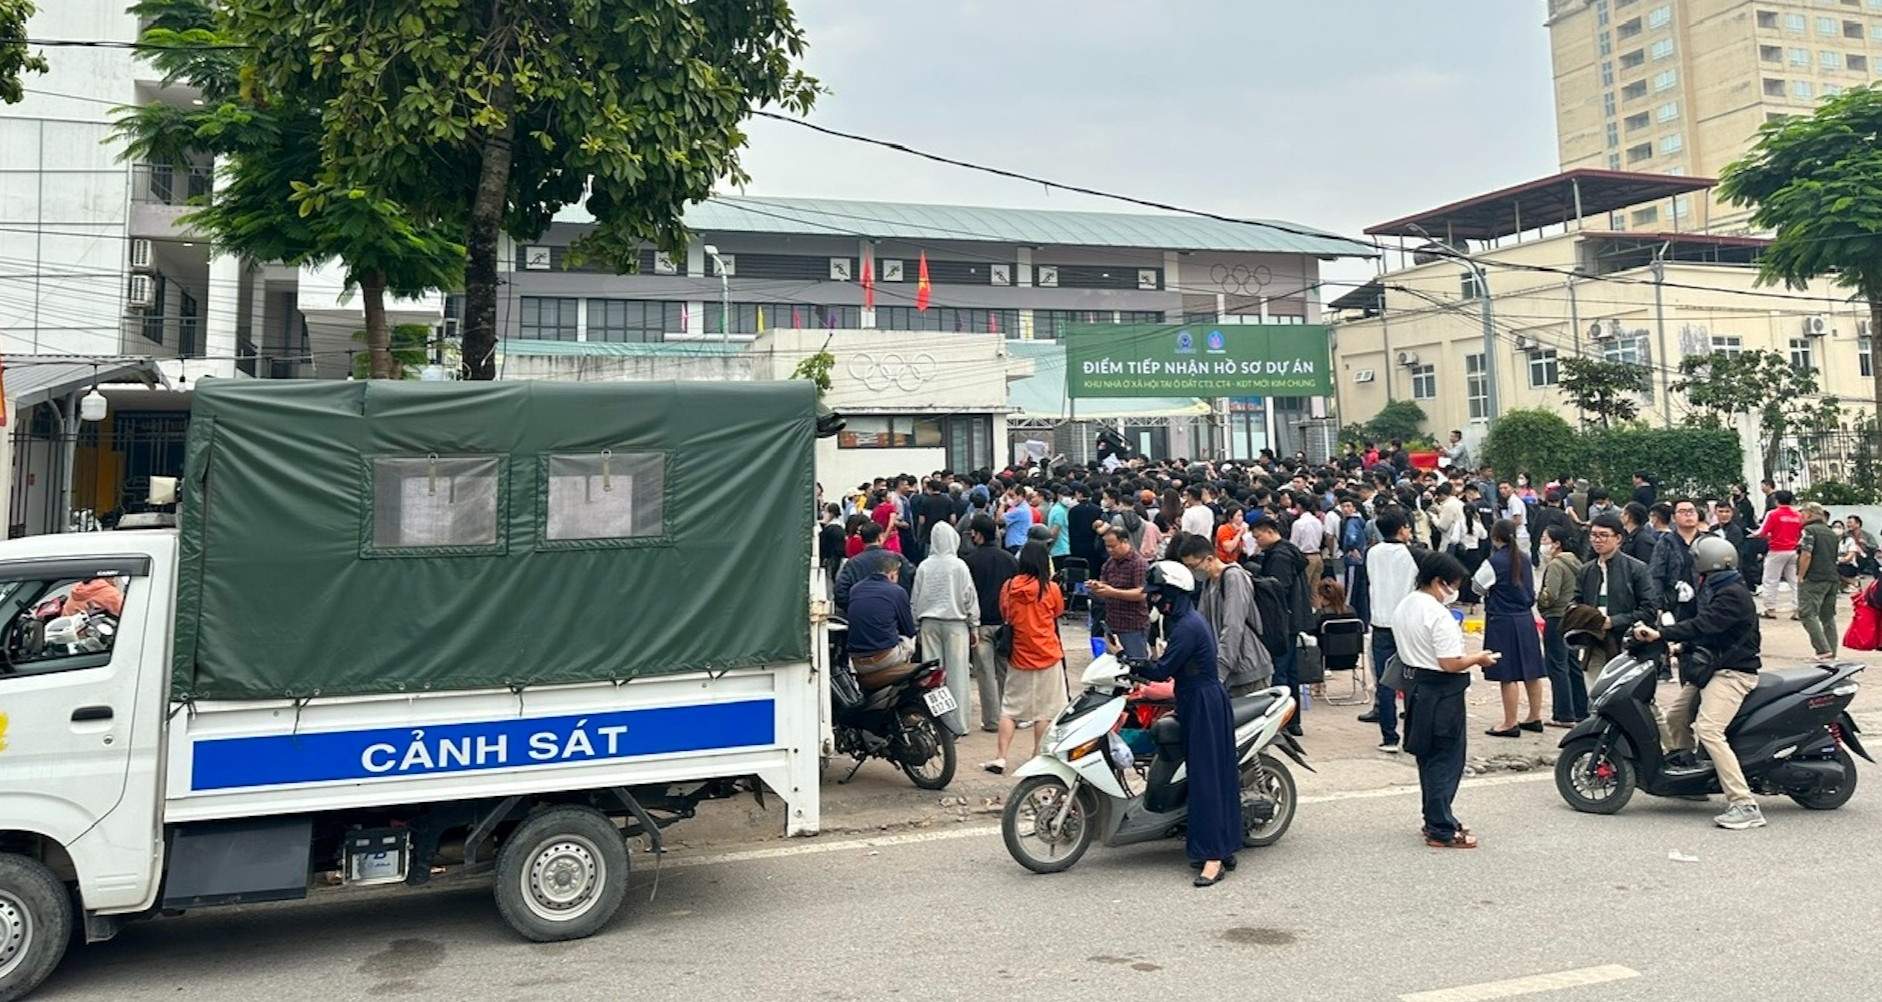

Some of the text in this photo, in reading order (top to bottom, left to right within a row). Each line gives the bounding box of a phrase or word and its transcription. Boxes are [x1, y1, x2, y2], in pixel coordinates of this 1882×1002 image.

[1127, 357, 1160, 374] TIẾP
[1165, 359, 1209, 377] NHẬN
[1214, 358, 1237, 374] HỒ
[1241, 360, 1262, 374] SƠ
[1266, 360, 1290, 377] DỰ
[1292, 358, 1314, 374] ÁN
[1287, 380, 1316, 388] CHUNG
[361, 719, 628, 773] CẢNH SÁT
